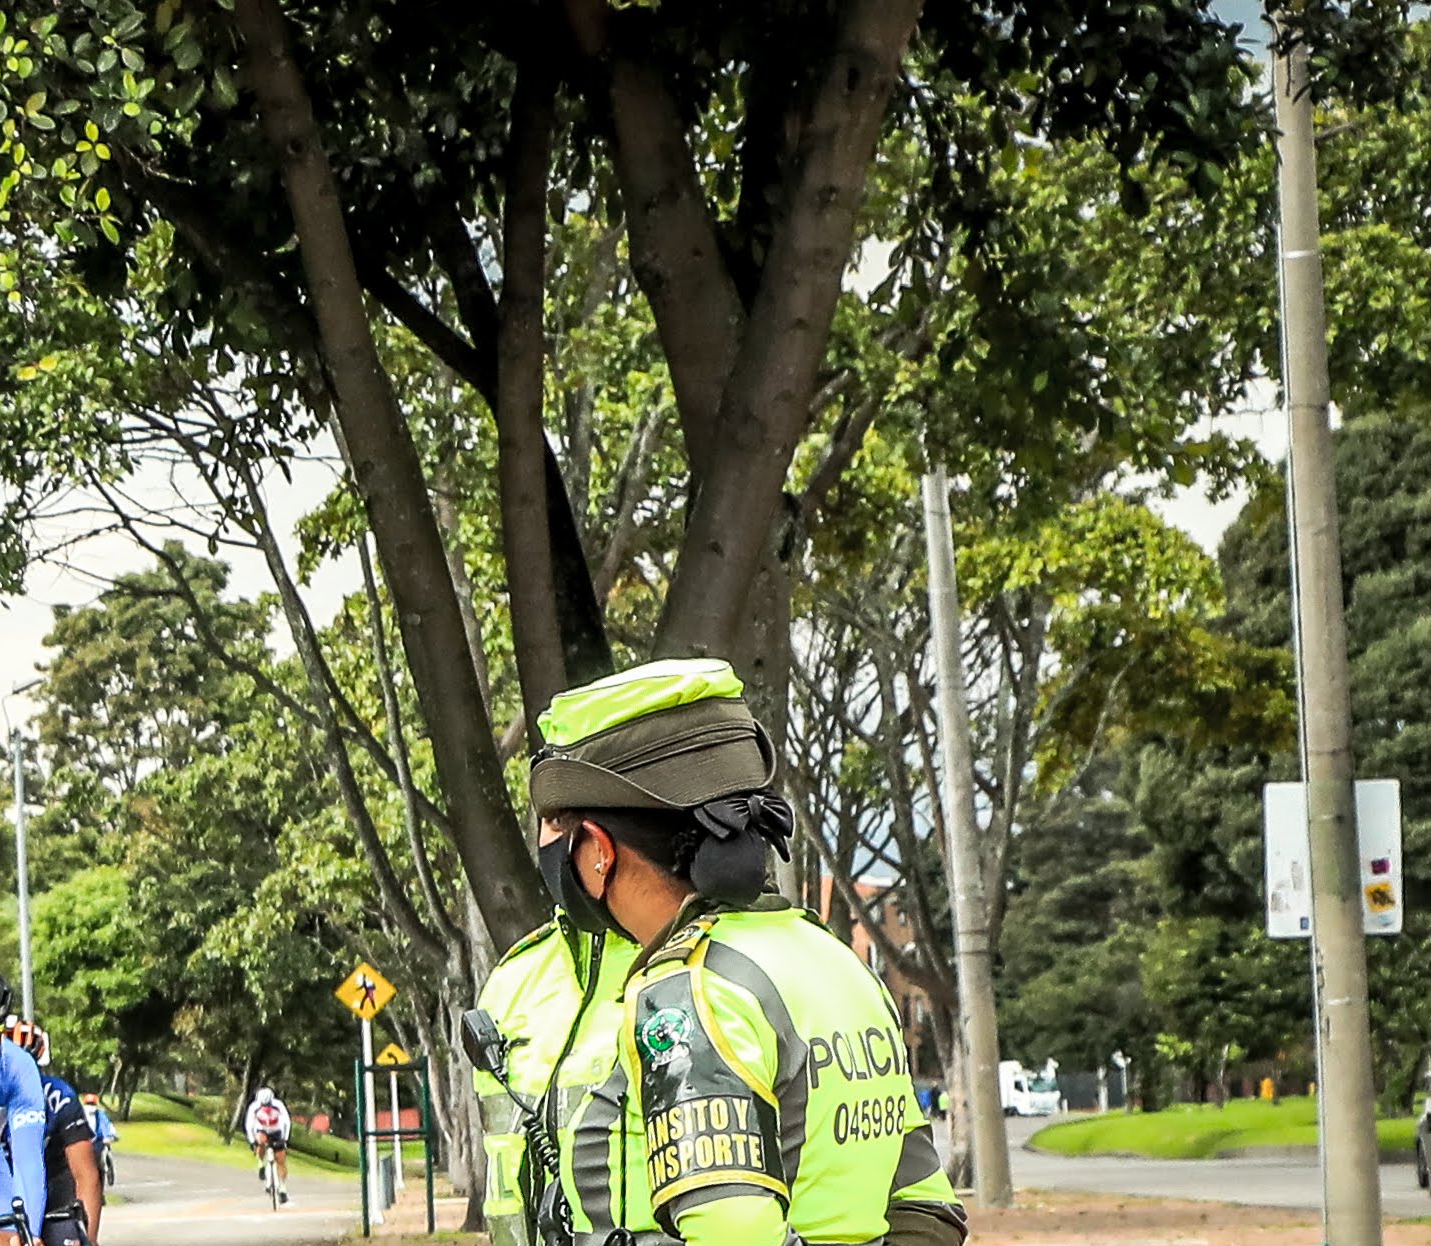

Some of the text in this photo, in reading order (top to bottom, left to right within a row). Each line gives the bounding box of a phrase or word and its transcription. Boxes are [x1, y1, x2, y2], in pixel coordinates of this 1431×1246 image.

[808, 1026, 906, 1090] POLICI
[732, 1098, 750, 1131] Y
[833, 1094, 906, 1146] 045988
